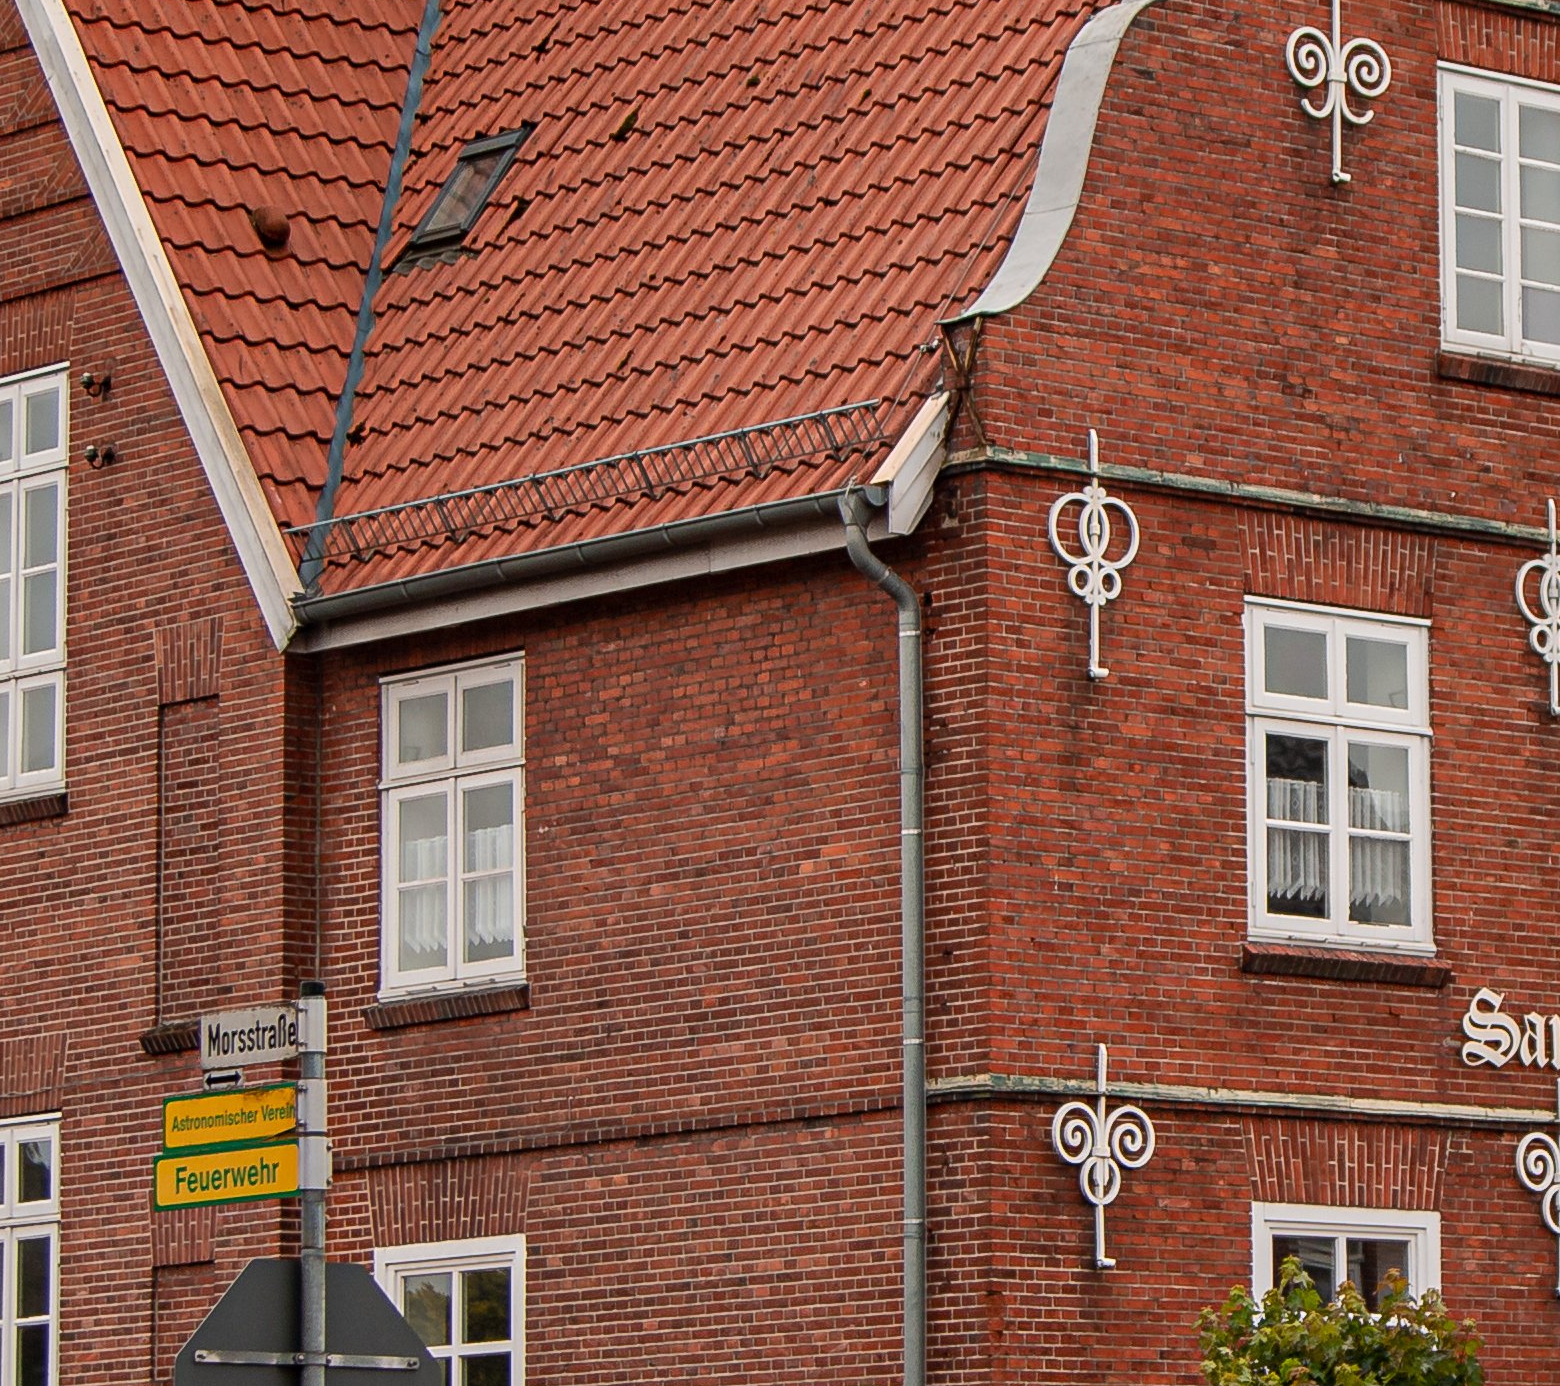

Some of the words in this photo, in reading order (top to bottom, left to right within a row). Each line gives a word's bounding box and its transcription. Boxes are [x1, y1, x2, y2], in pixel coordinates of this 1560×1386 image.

[207, 1013, 297, 1057] Morsstraße
[171, 1108, 258, 1132] Astronomischer
[261, 1103, 296, 1122] Verein
[175, 1157, 280, 1194] Feuerwehr
